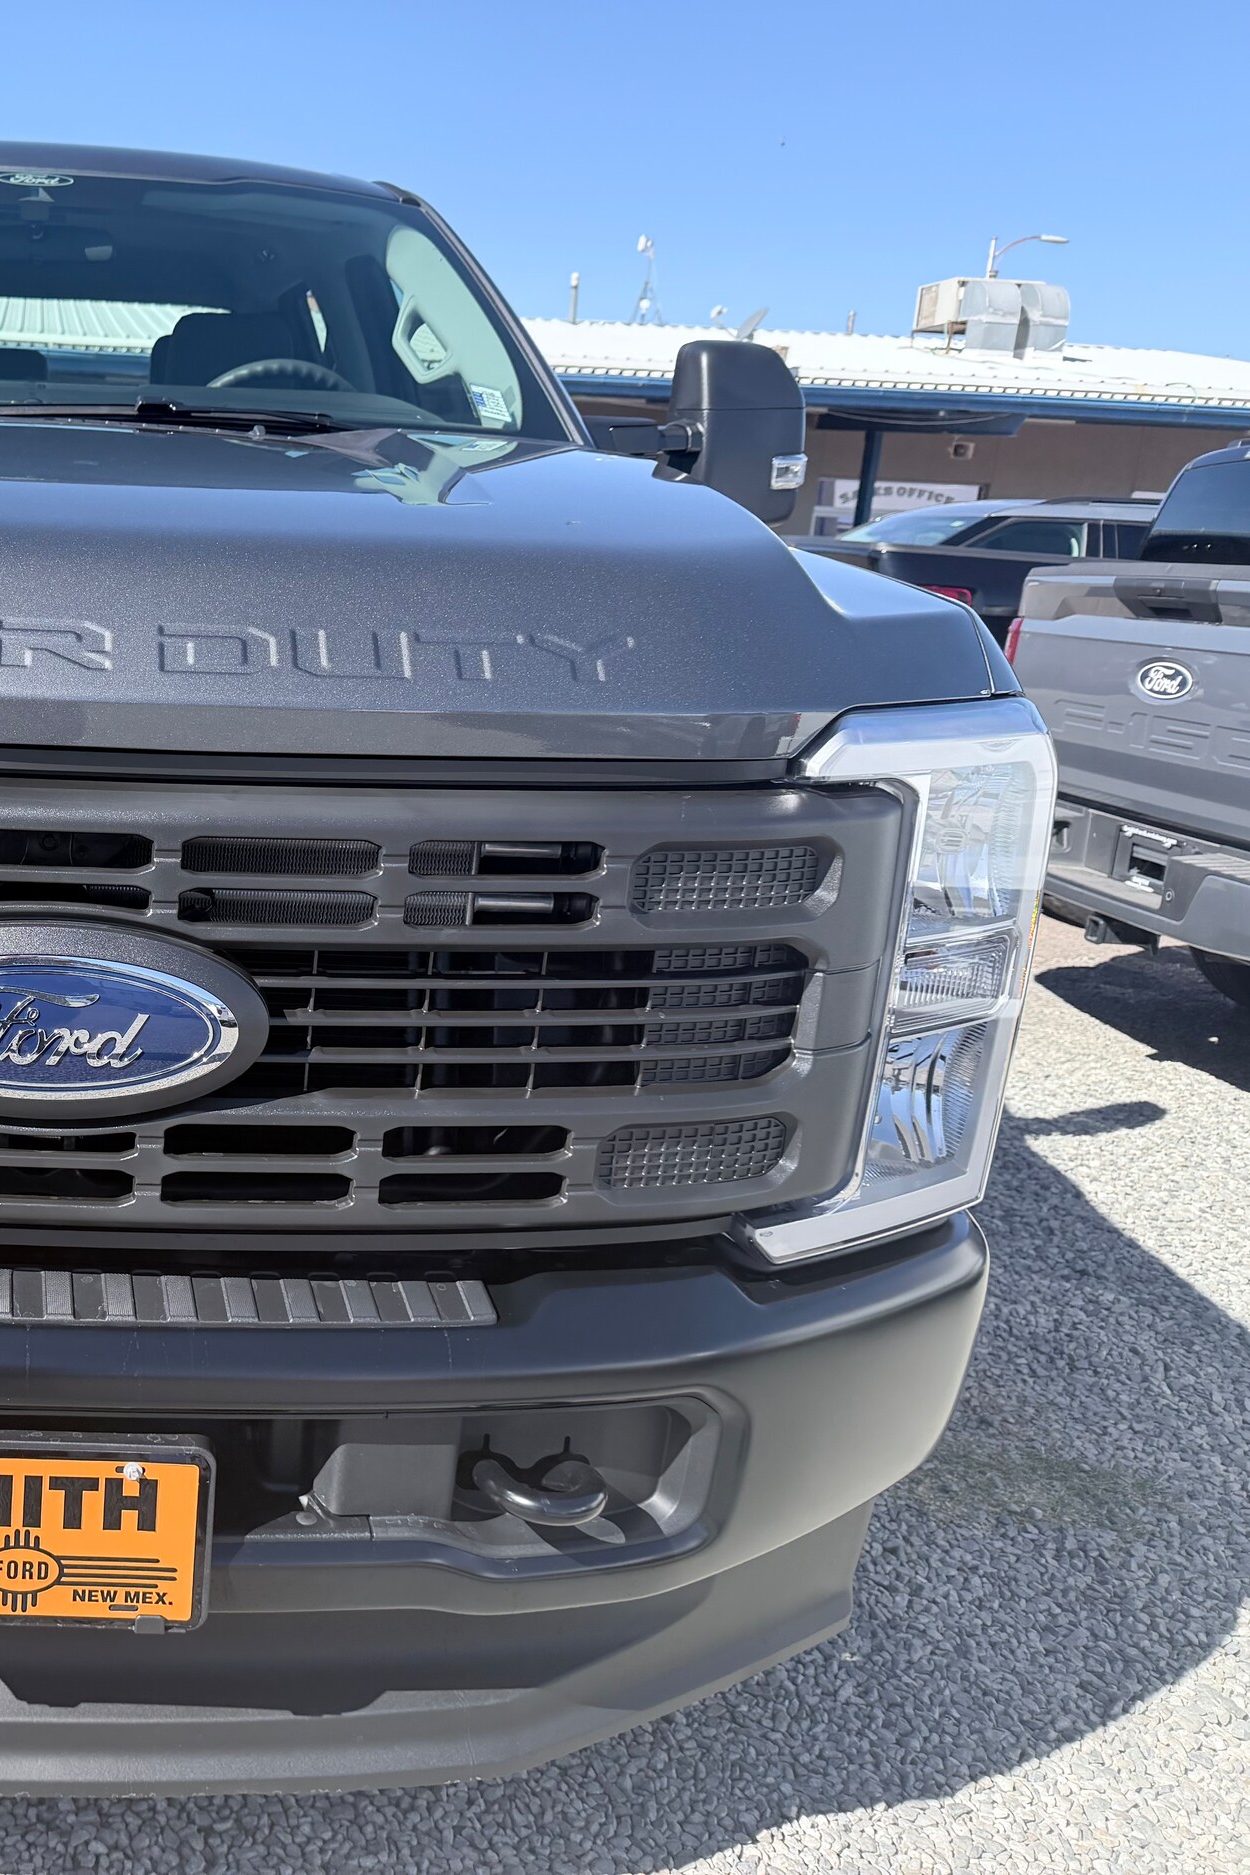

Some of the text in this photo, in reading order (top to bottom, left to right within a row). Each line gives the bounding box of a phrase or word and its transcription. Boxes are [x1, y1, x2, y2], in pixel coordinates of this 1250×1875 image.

[10, 173, 60, 185] Ford
[838, 486, 956, 505] SES OFFICE
[157, 622, 637, 682] DUTY
[1143, 665, 1183, 694] Ford
[72, 1588, 174, 1607] NEW MEX.
